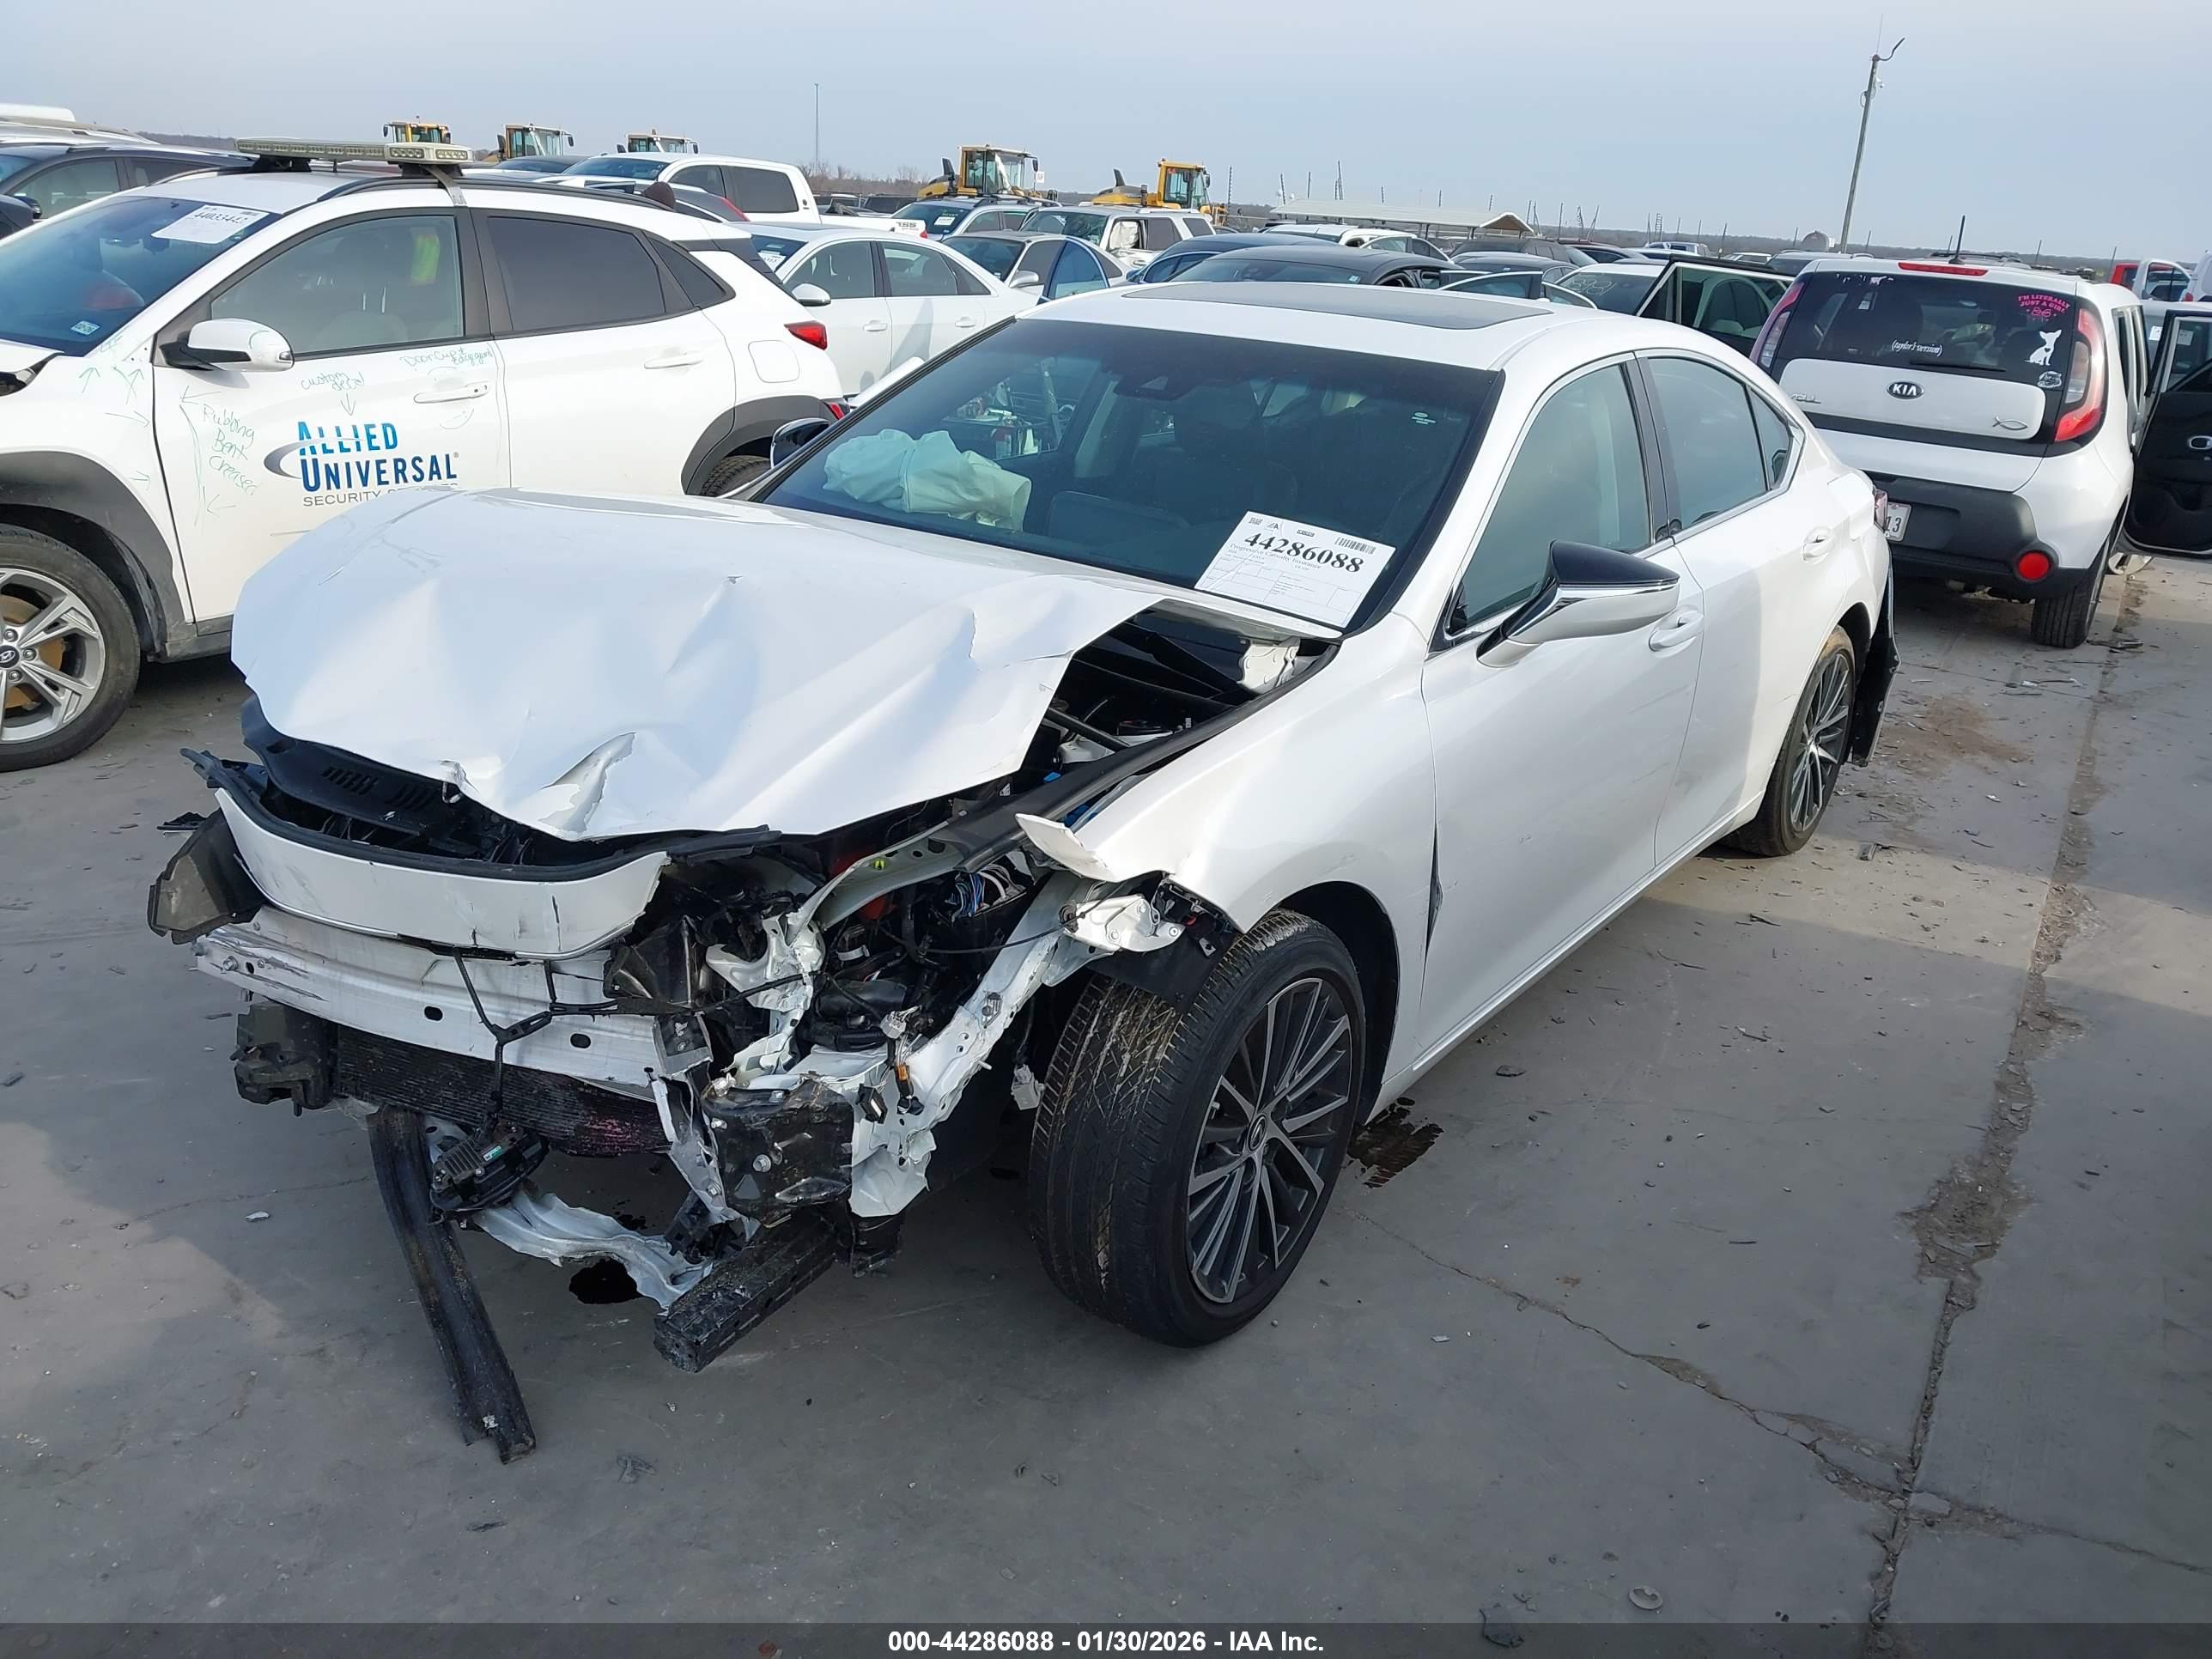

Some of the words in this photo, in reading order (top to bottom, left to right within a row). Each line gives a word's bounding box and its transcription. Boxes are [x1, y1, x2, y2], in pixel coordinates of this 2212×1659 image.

[2031, 295, 2070, 309] LITERALLY
[1892, 383, 1917, 396] KIA
[297, 421, 398, 456] ALLIED
[303, 489, 382, 507] SECURITY
[1244, 532, 1364, 573] 44286088
